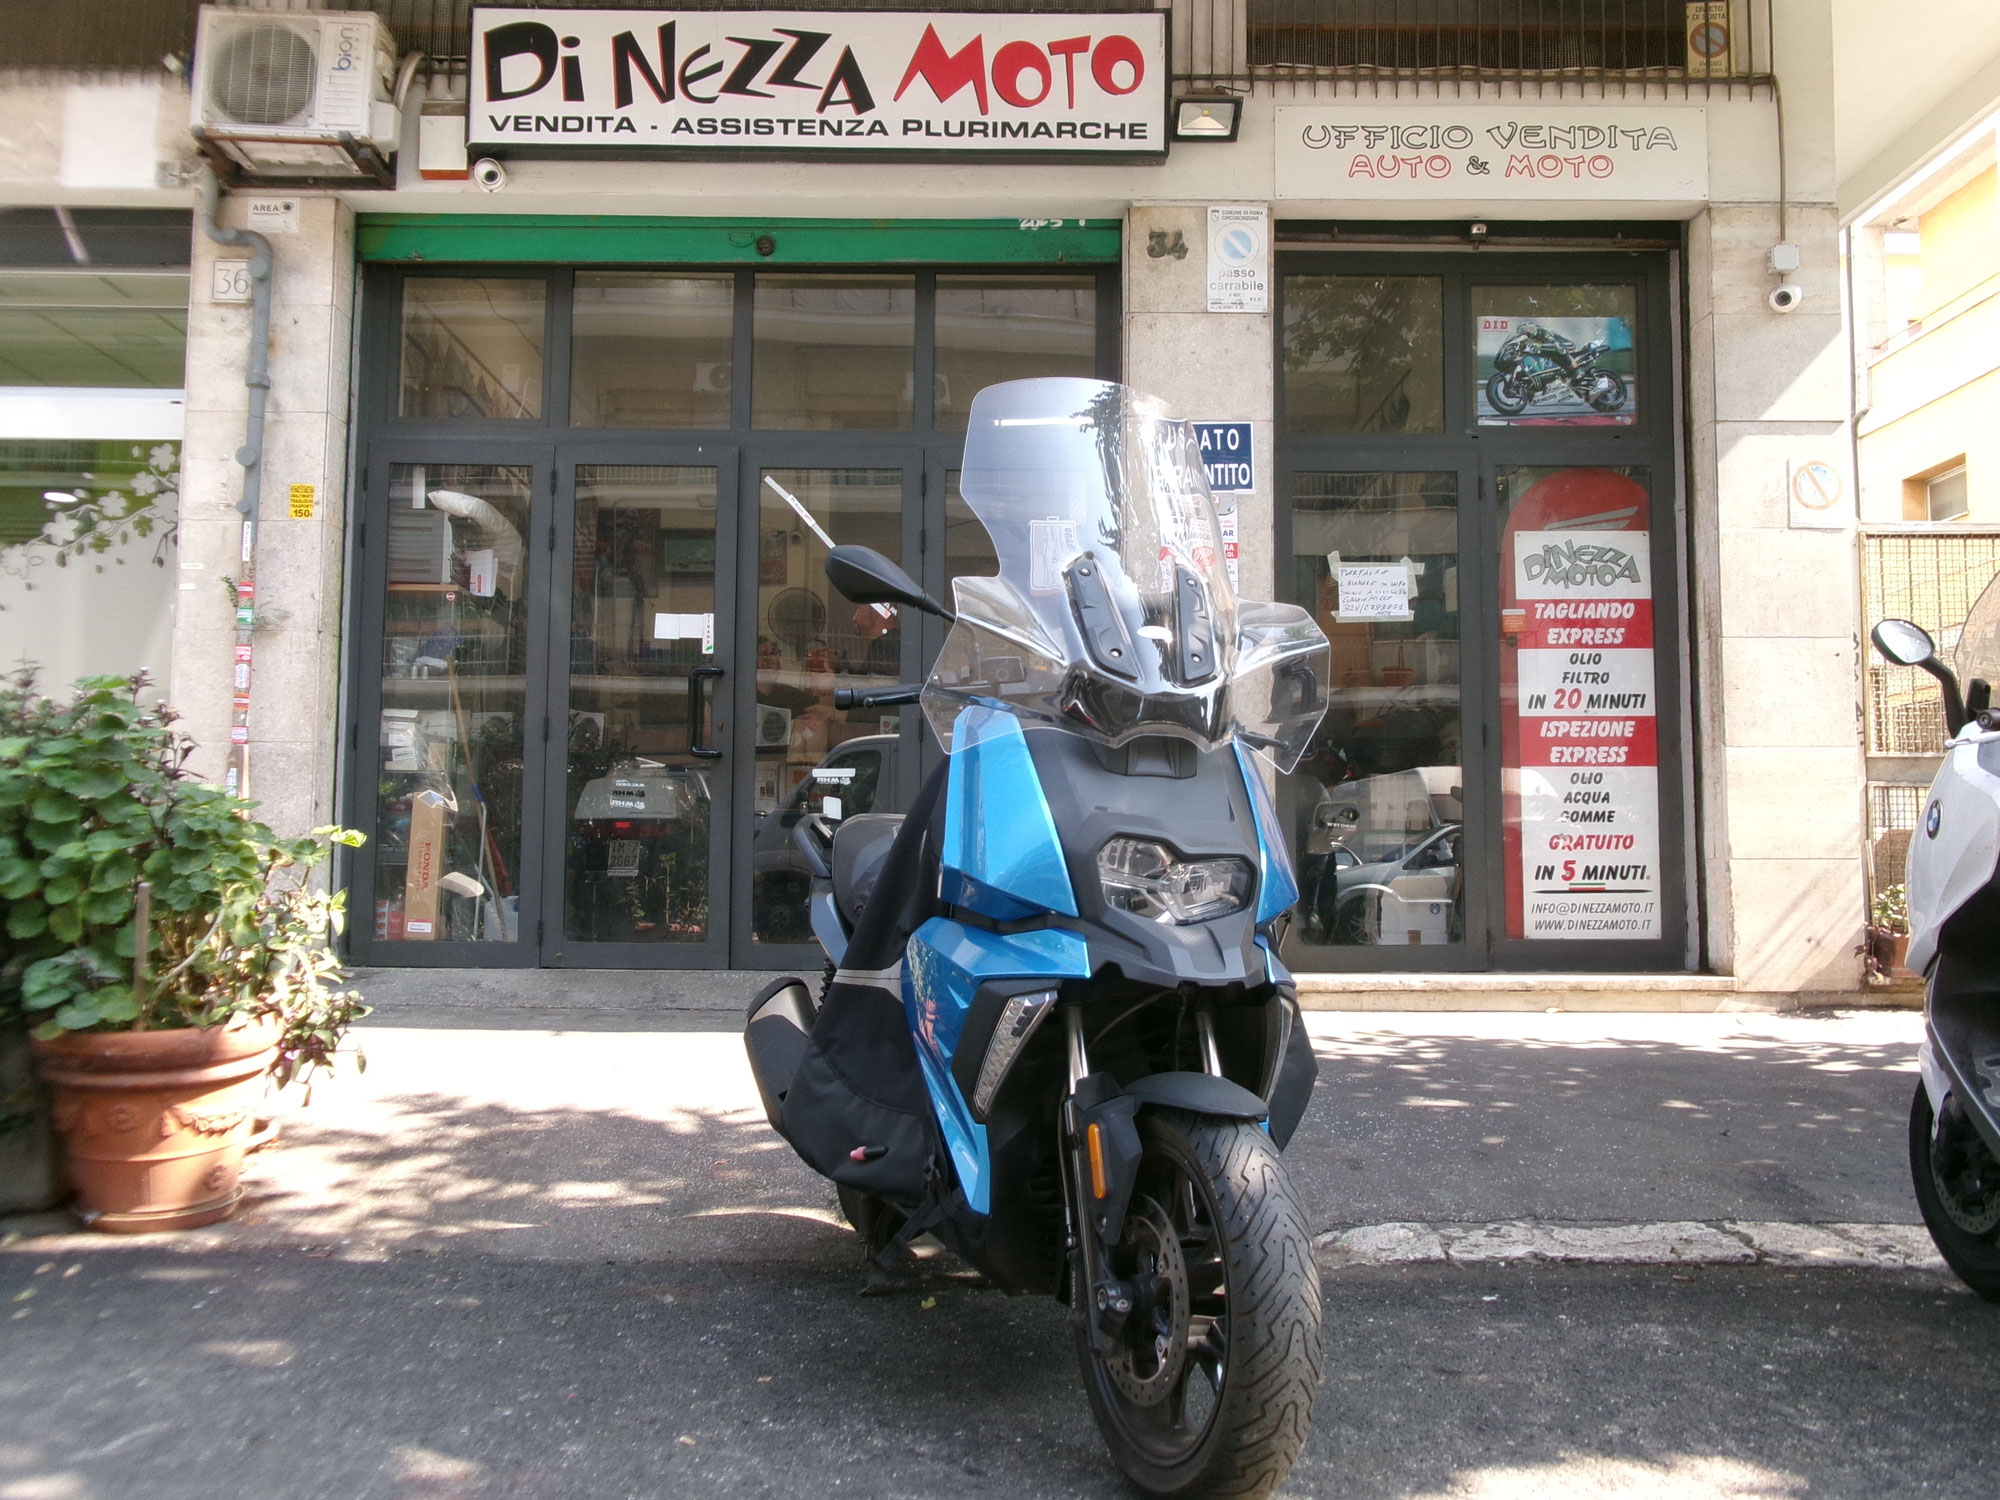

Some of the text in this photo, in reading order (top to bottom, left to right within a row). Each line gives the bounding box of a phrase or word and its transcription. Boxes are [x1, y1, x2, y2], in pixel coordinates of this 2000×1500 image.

[331, 27, 353, 70] bion
[483, 21, 585, 103] Di
[893, 21, 1145, 116] MOTO
[488, 115, 637, 133] VENDITA
[671, 118, 889, 137] ASSISTENZA
[902, 119, 1148, 140] PLURIMARCHE
[1302, 121, 1678, 151] UFFICIO VENDITA
[1348, 154, 1614, 179] AUTO & MOTO
[252, 204, 280, 212] AREA
[216, 268, 249, 294] 36
[1219, 269, 1255, 279] passo
[1210, 280, 1264, 291] carrabile
[1542, 563, 1617, 589] MOTO
[1534, 602, 1635, 619] TAGLIANDO
[1547, 627, 1625, 645] EXPRESS
[1569, 653, 1602, 665] OLIO
[1562, 671, 1610, 685] FILTRO
[1528, 688, 1646, 709] IN 20 MINUTI
[1540, 720, 1636, 738] ISPEZIONE
[1550, 746, 1629, 764] EXPRESS
[1570, 772, 1603, 785] OLIO
[1563, 791, 1610, 805] ACQUA
[1561, 810, 1615, 823] GOMME
[1549, 833, 1635, 851] GRATUITO
[421, 841, 432, 890] HONDA
[1534, 860, 1646, 881] IN 5 MINUTI
[1531, 902, 1655, 915] INFO@DINEZZAMOTO.IT
[1534, 919, 1652, 931] WWW.DINEZZAMOTO.IT
